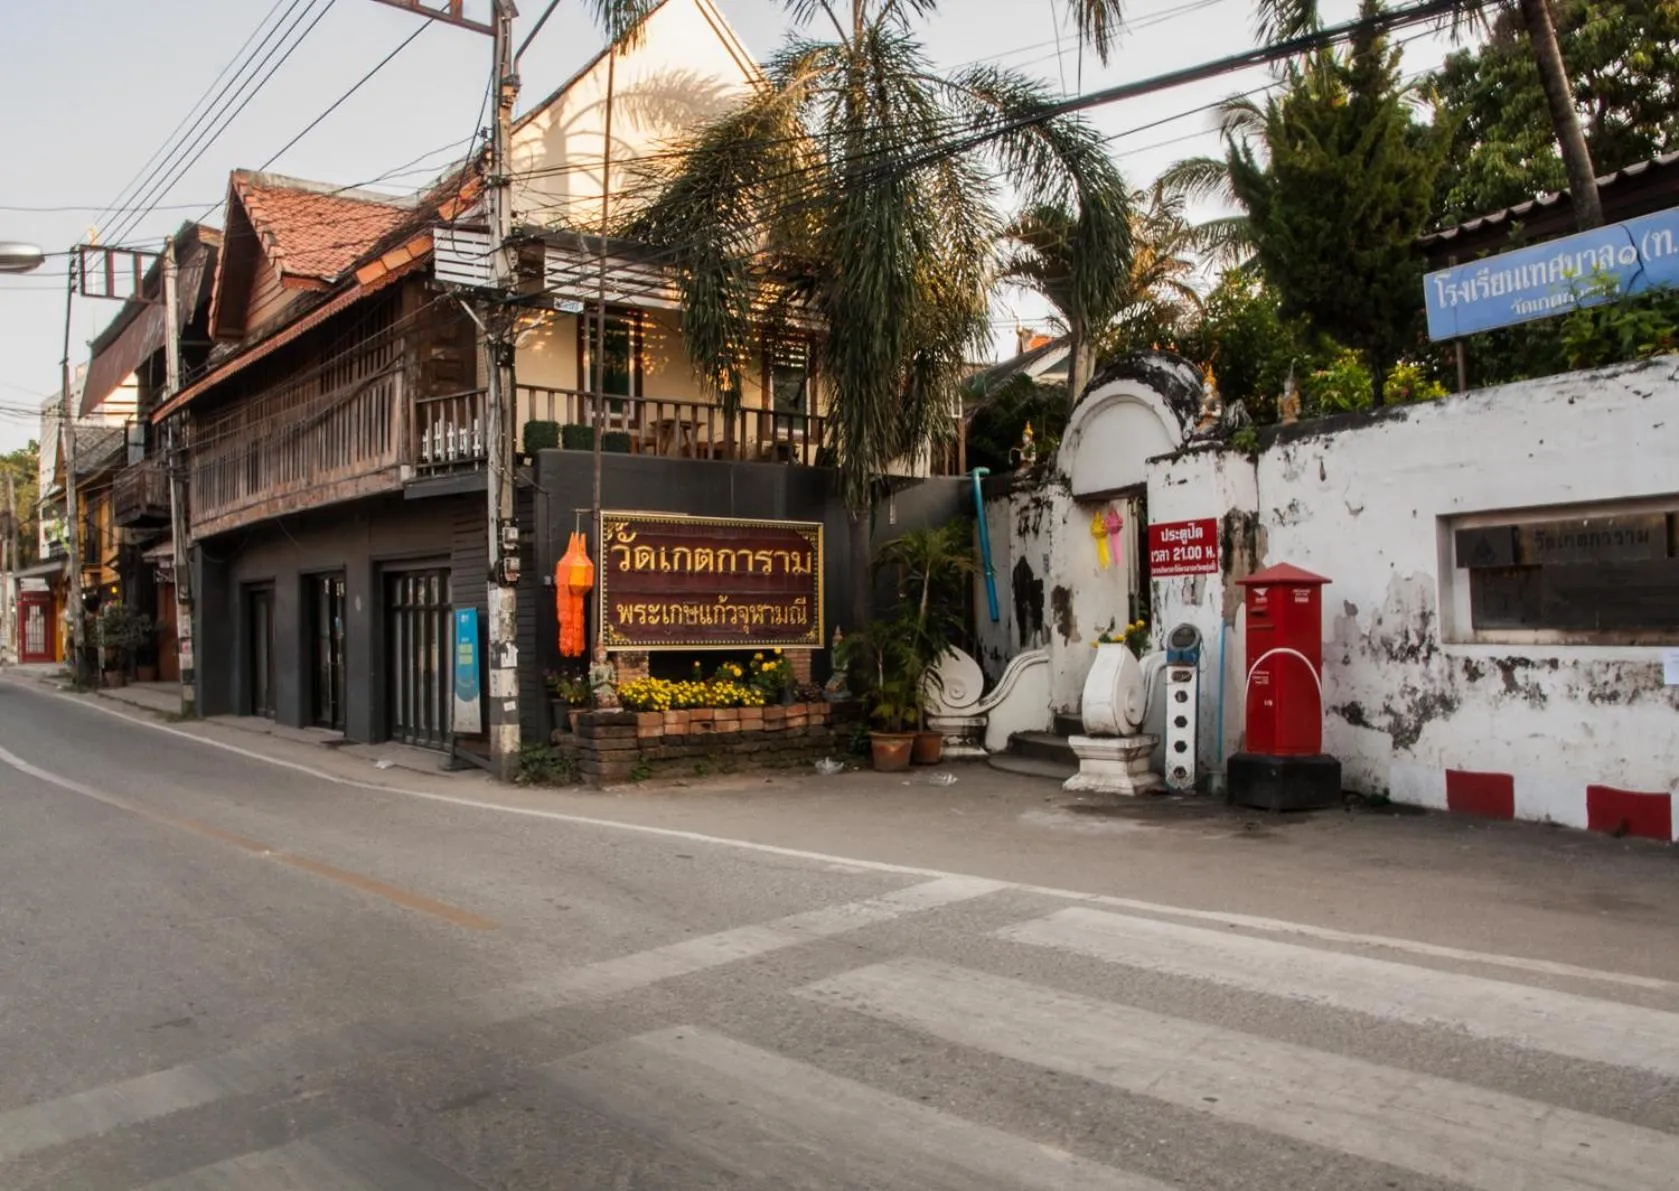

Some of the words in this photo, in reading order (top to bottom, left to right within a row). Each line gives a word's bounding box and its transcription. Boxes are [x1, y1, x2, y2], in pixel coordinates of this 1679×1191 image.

[1160, 522, 1204, 545] ประตูปิด
[610, 528, 812, 575] วัดเกตการาม
[1151, 549, 1170, 563] เวลา
[1173, 545, 1202, 562] 21.00
